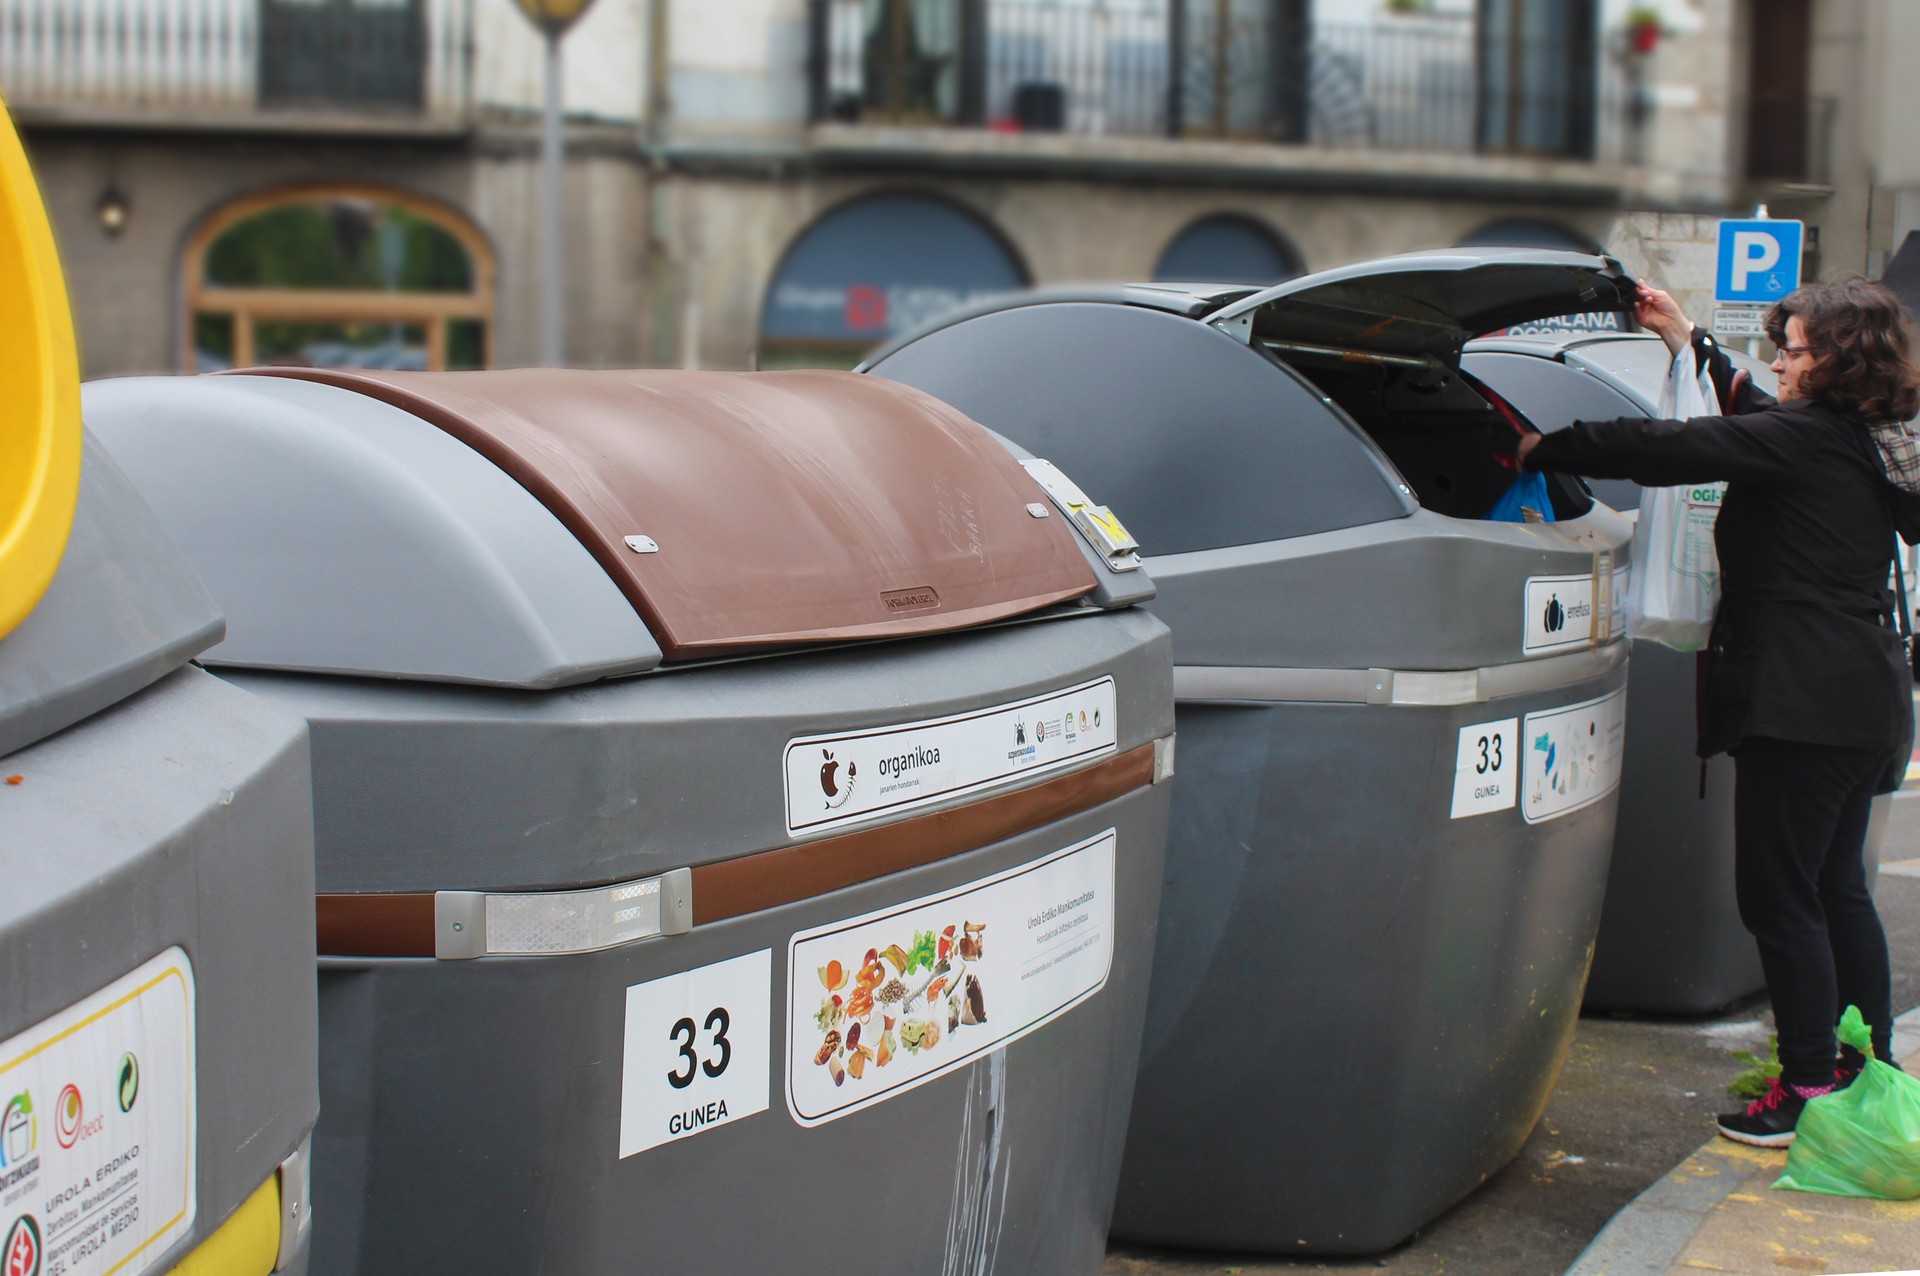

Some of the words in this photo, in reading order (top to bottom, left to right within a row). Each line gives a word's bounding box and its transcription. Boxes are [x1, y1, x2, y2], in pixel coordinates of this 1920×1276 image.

[1731, 231, 1780, 291] P
[879, 745, 940, 778] organikoa
[1476, 733, 1502, 774] 33
[1474, 785, 1500, 799] GUNEA
[667, 1007, 731, 1089] 33
[669, 1099, 728, 1134] GUNEA
[46, 1177, 91, 1213] UROLA
[96, 1144, 139, 1181] ERDIKO
[72, 1230, 107, 1265] UROLA
[111, 1206, 139, 1238] MEDIO
